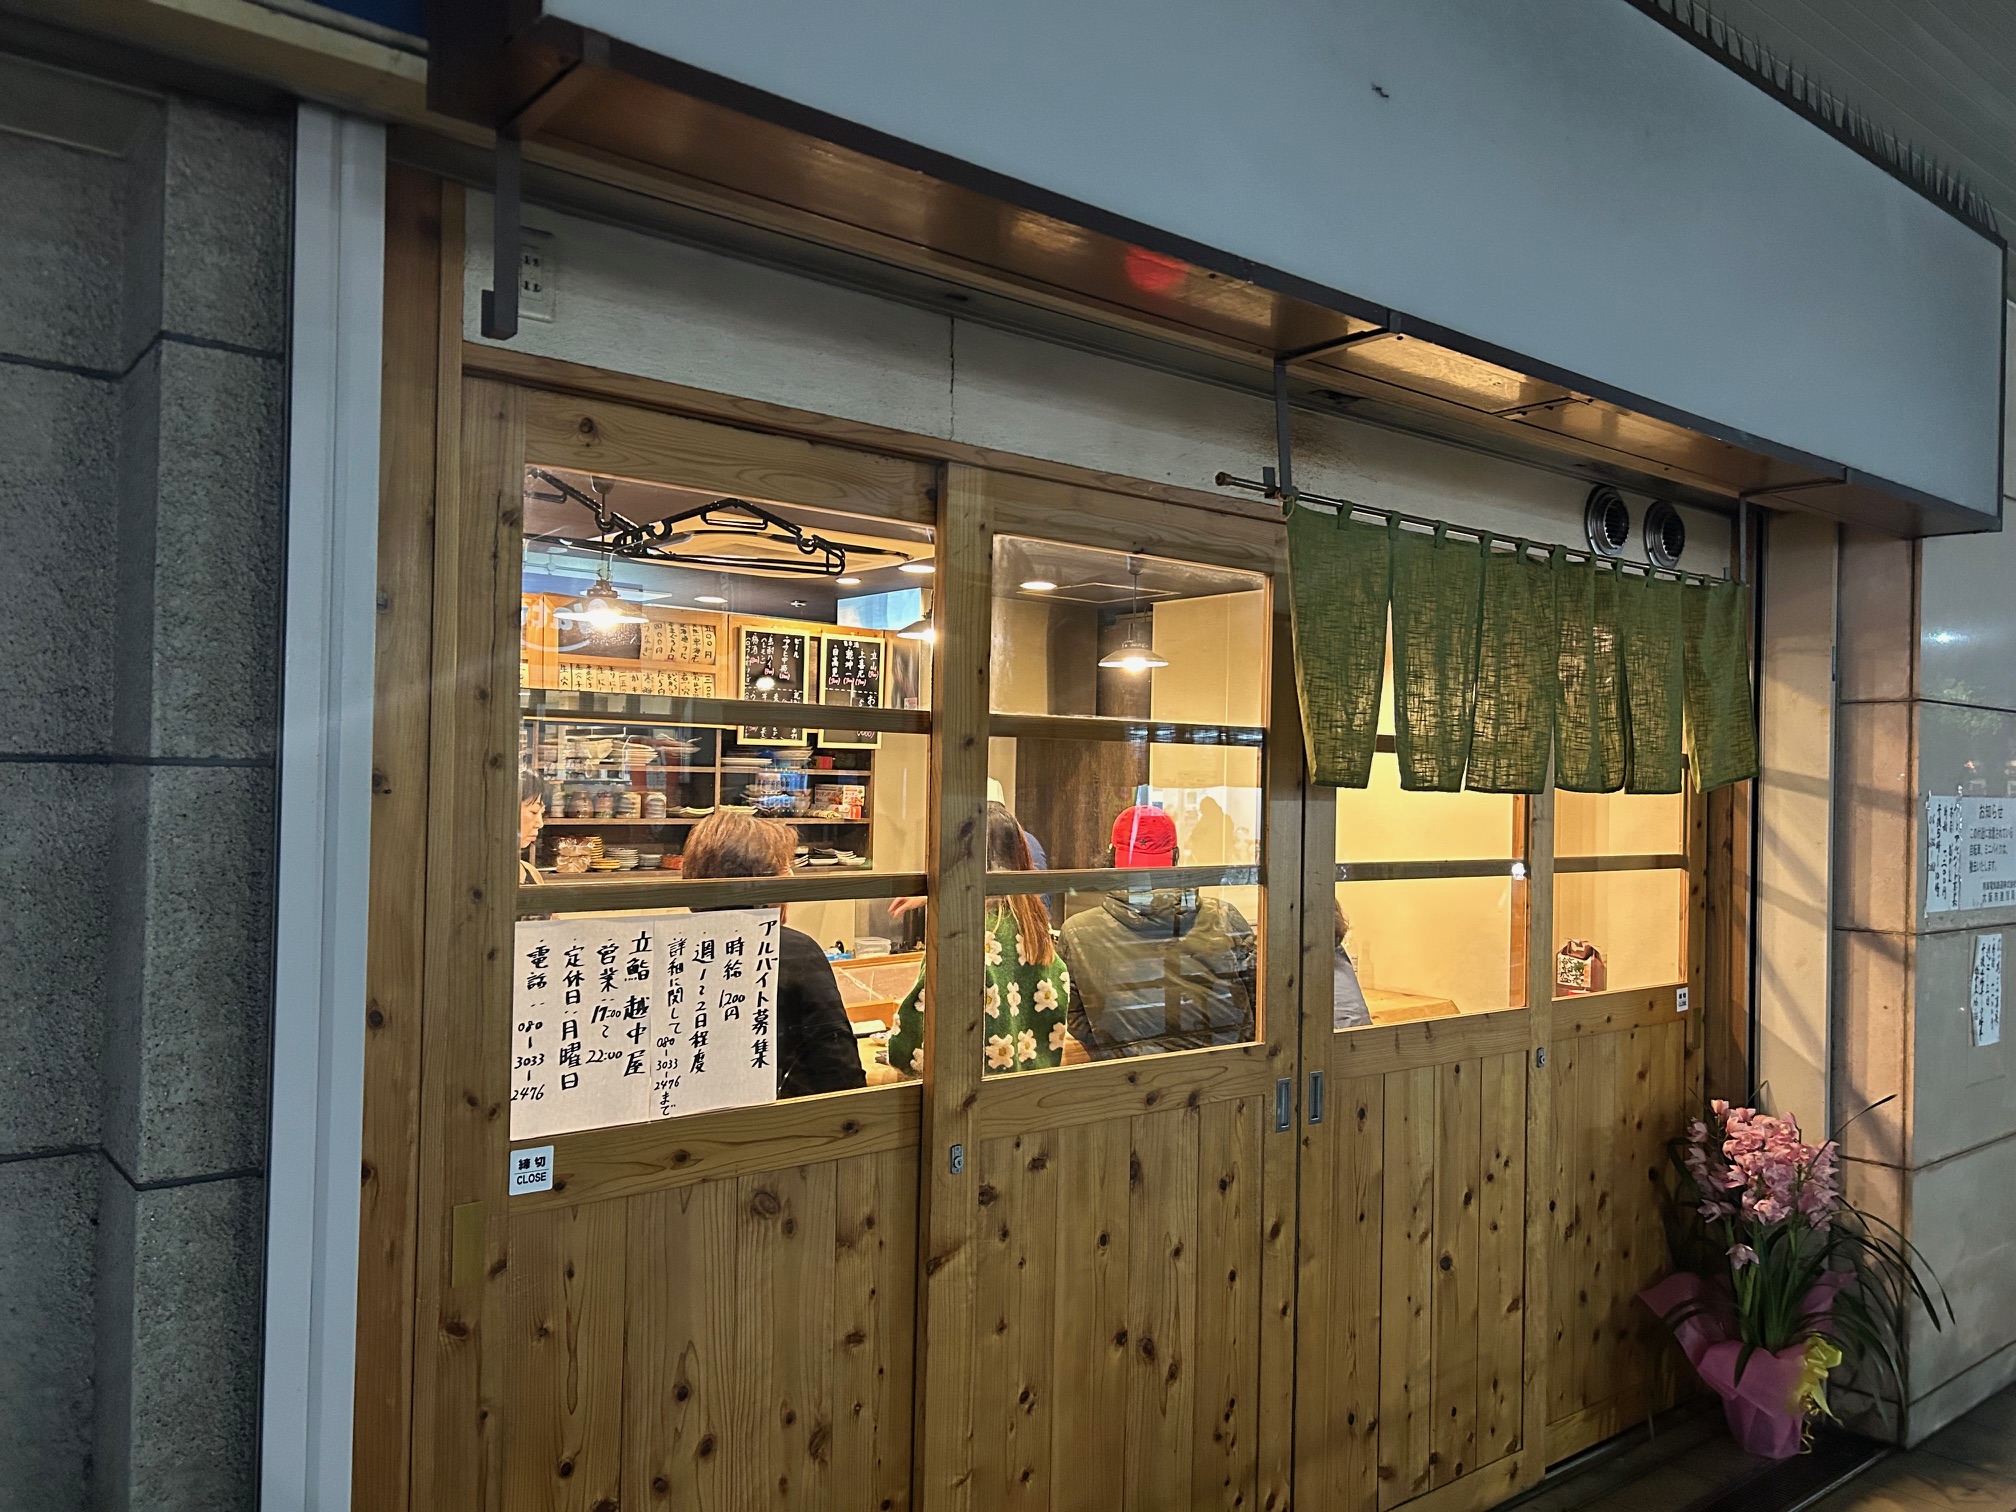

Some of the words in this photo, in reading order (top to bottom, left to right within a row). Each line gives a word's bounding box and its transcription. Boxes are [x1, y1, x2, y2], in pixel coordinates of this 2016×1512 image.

[1979, 804, 2004, 820] お知らせ
[751, 920, 778, 1069] アルバイト募集
[518, 1156, 546, 1171] 締切
[516, 1172, 547, 1186] CLOSE
